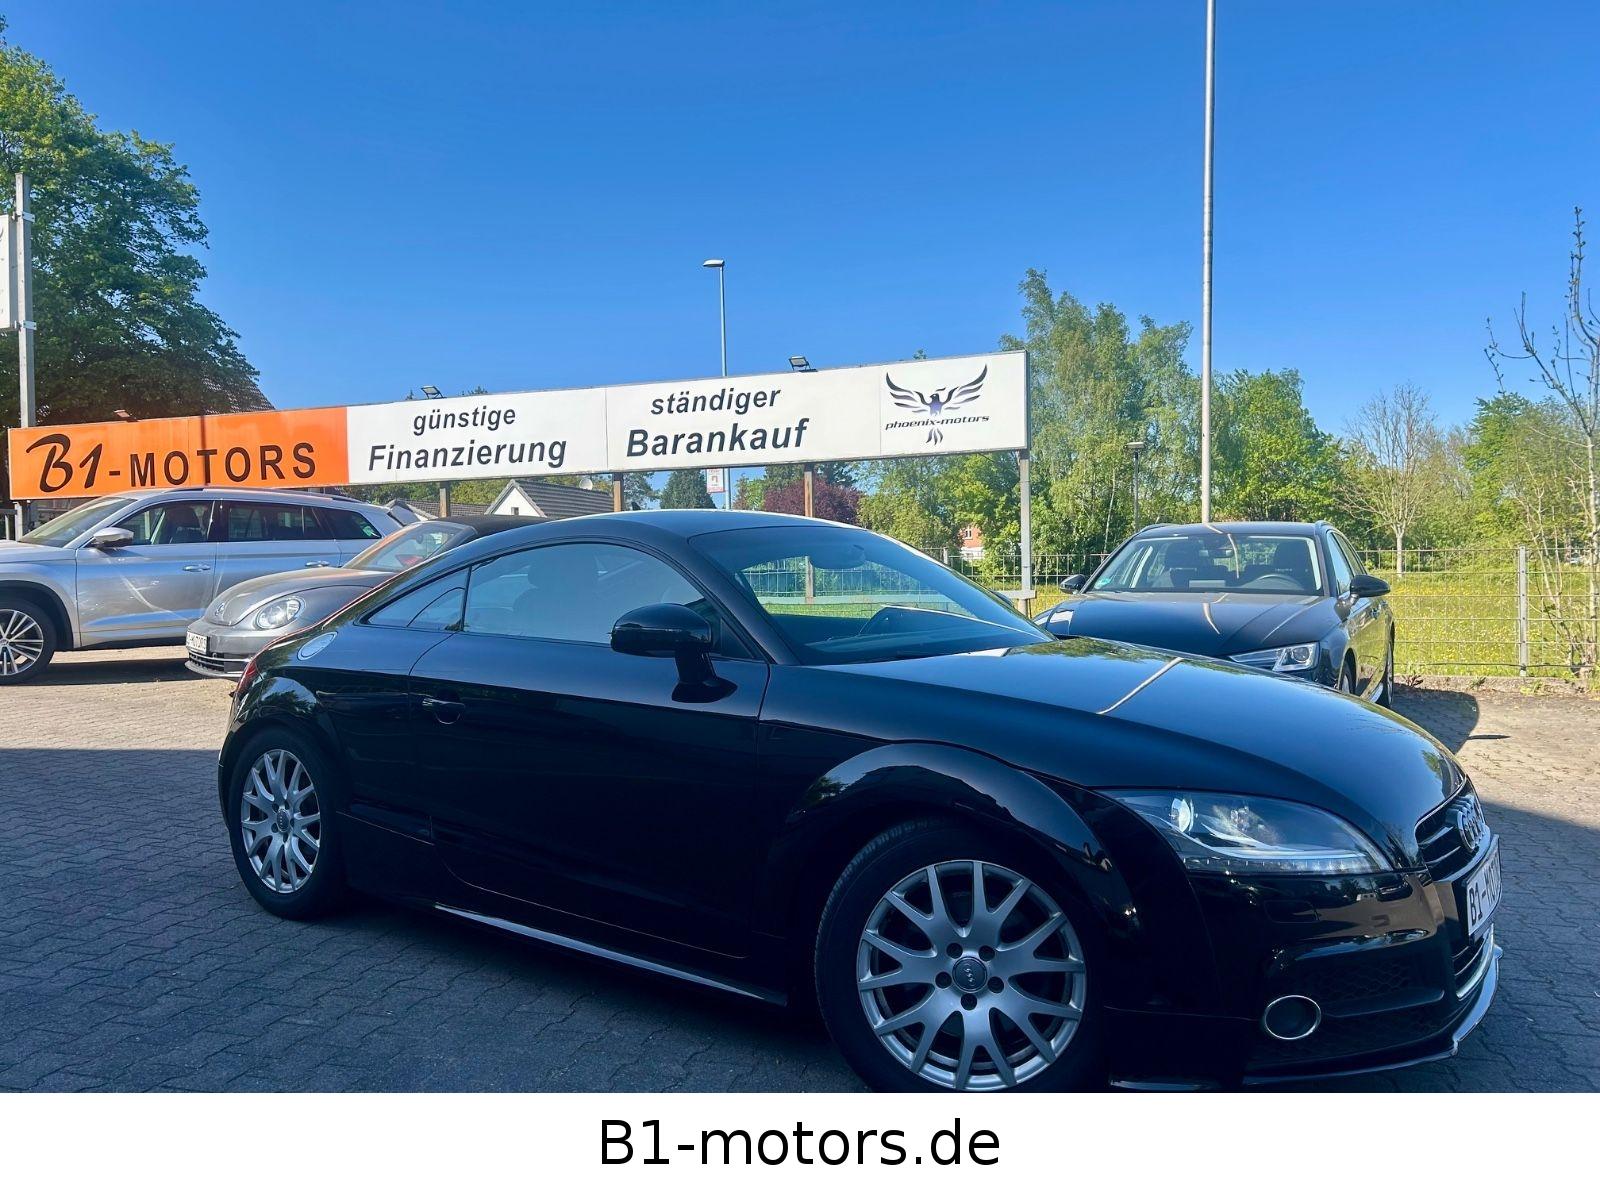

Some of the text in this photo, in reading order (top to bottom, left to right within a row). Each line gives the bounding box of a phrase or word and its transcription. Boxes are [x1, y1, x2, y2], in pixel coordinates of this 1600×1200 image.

[650, 387, 781, 415] ständiger
[413, 405, 516, 436] günstige
[885, 415, 990, 430] phoenix-motors
[626, 417, 810, 457] Barankauf
[25, 433, 317, 493] B1-MOTORS
[368, 439, 567, 471] Finanzierung
